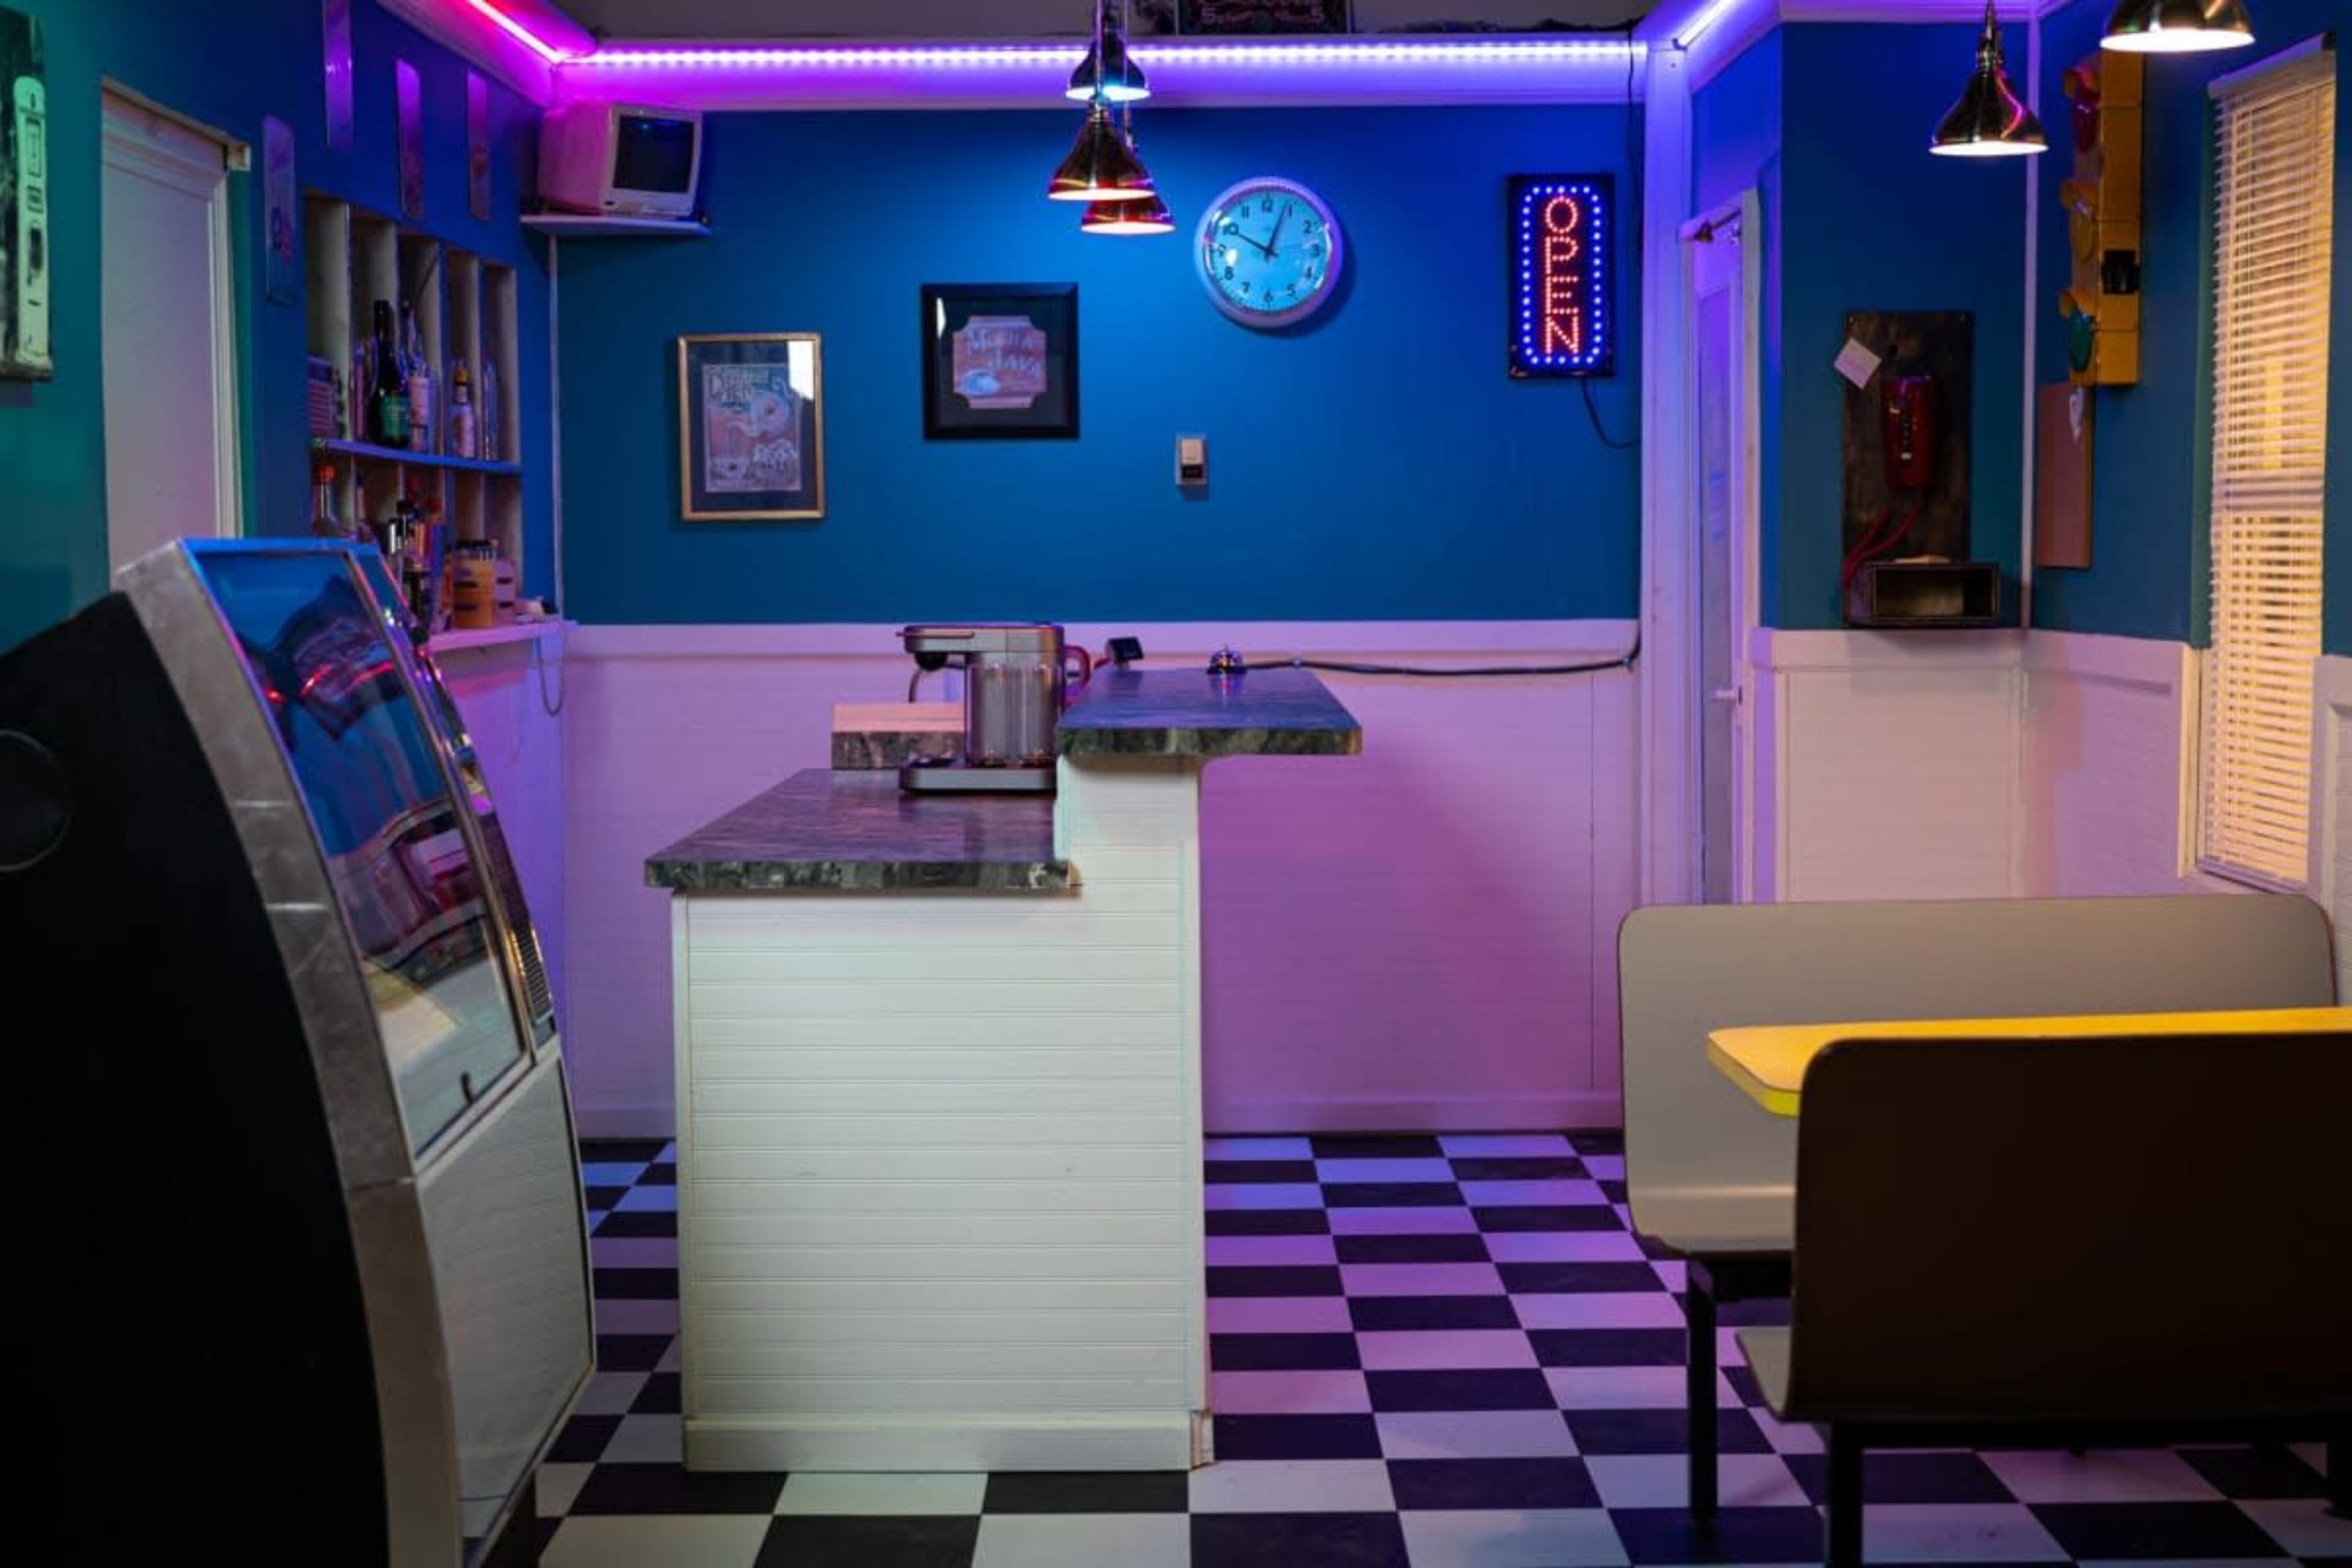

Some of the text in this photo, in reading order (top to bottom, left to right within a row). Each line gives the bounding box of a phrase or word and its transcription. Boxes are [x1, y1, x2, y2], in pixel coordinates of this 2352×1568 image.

[1242, 205, 1250, 219] 11
[1261, 200, 1273, 212] 12
[1223, 224, 1239, 236] 10
[1303, 221, 1312, 234] 2
[1226, 266, 1234, 281] 8
[1545, 195, 1578, 353] OPEN
[1242, 282, 1250, 293] 7
[1287, 284, 1296, 297] 5
[1264, 290, 1273, 303] 6
